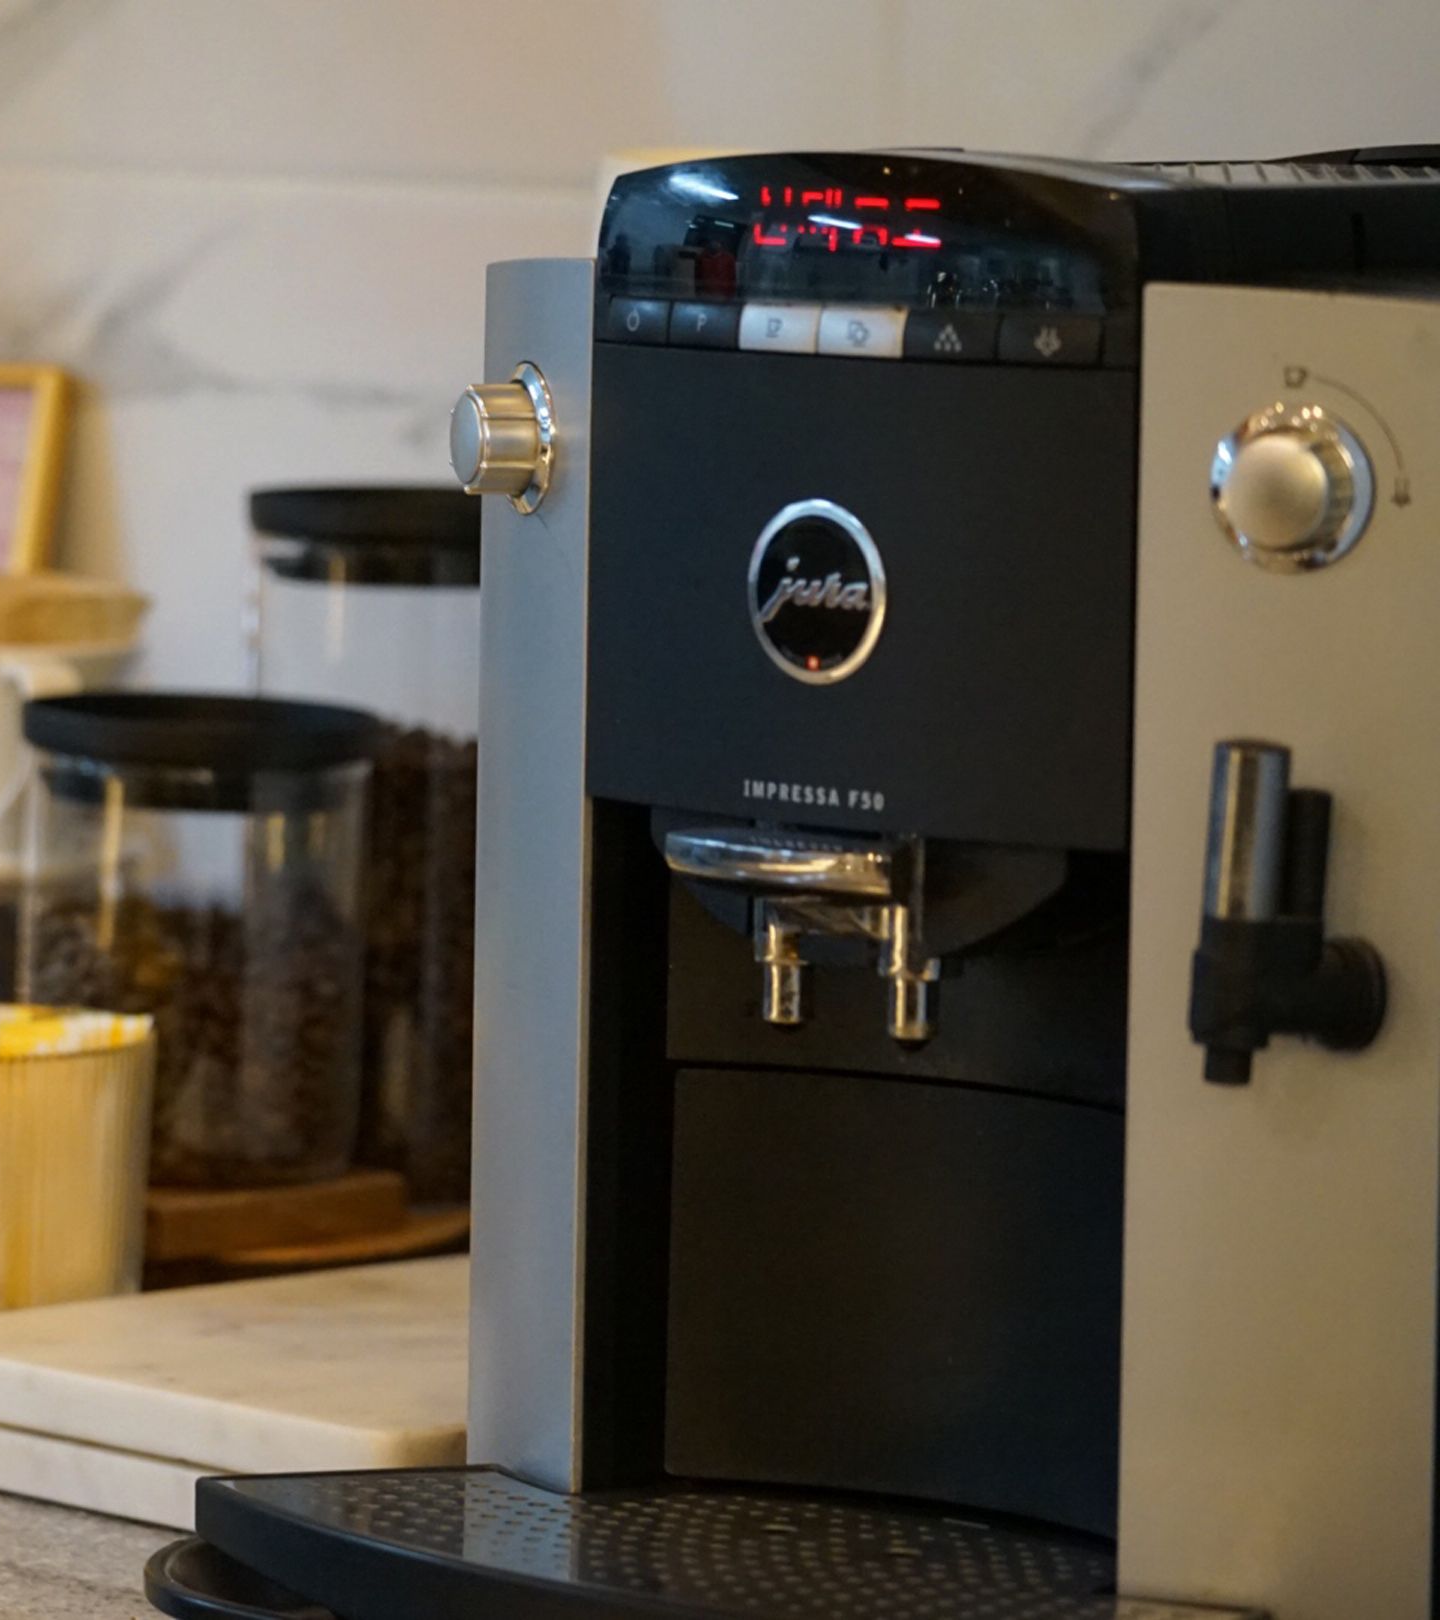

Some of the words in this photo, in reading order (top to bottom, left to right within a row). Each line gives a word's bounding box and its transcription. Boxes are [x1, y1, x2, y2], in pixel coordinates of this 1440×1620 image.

[696, 312, 708, 332] P
[759, 556, 869, 623] jura
[743, 778, 840, 808] IMPRESSA
[847, 788, 885, 812] F50
